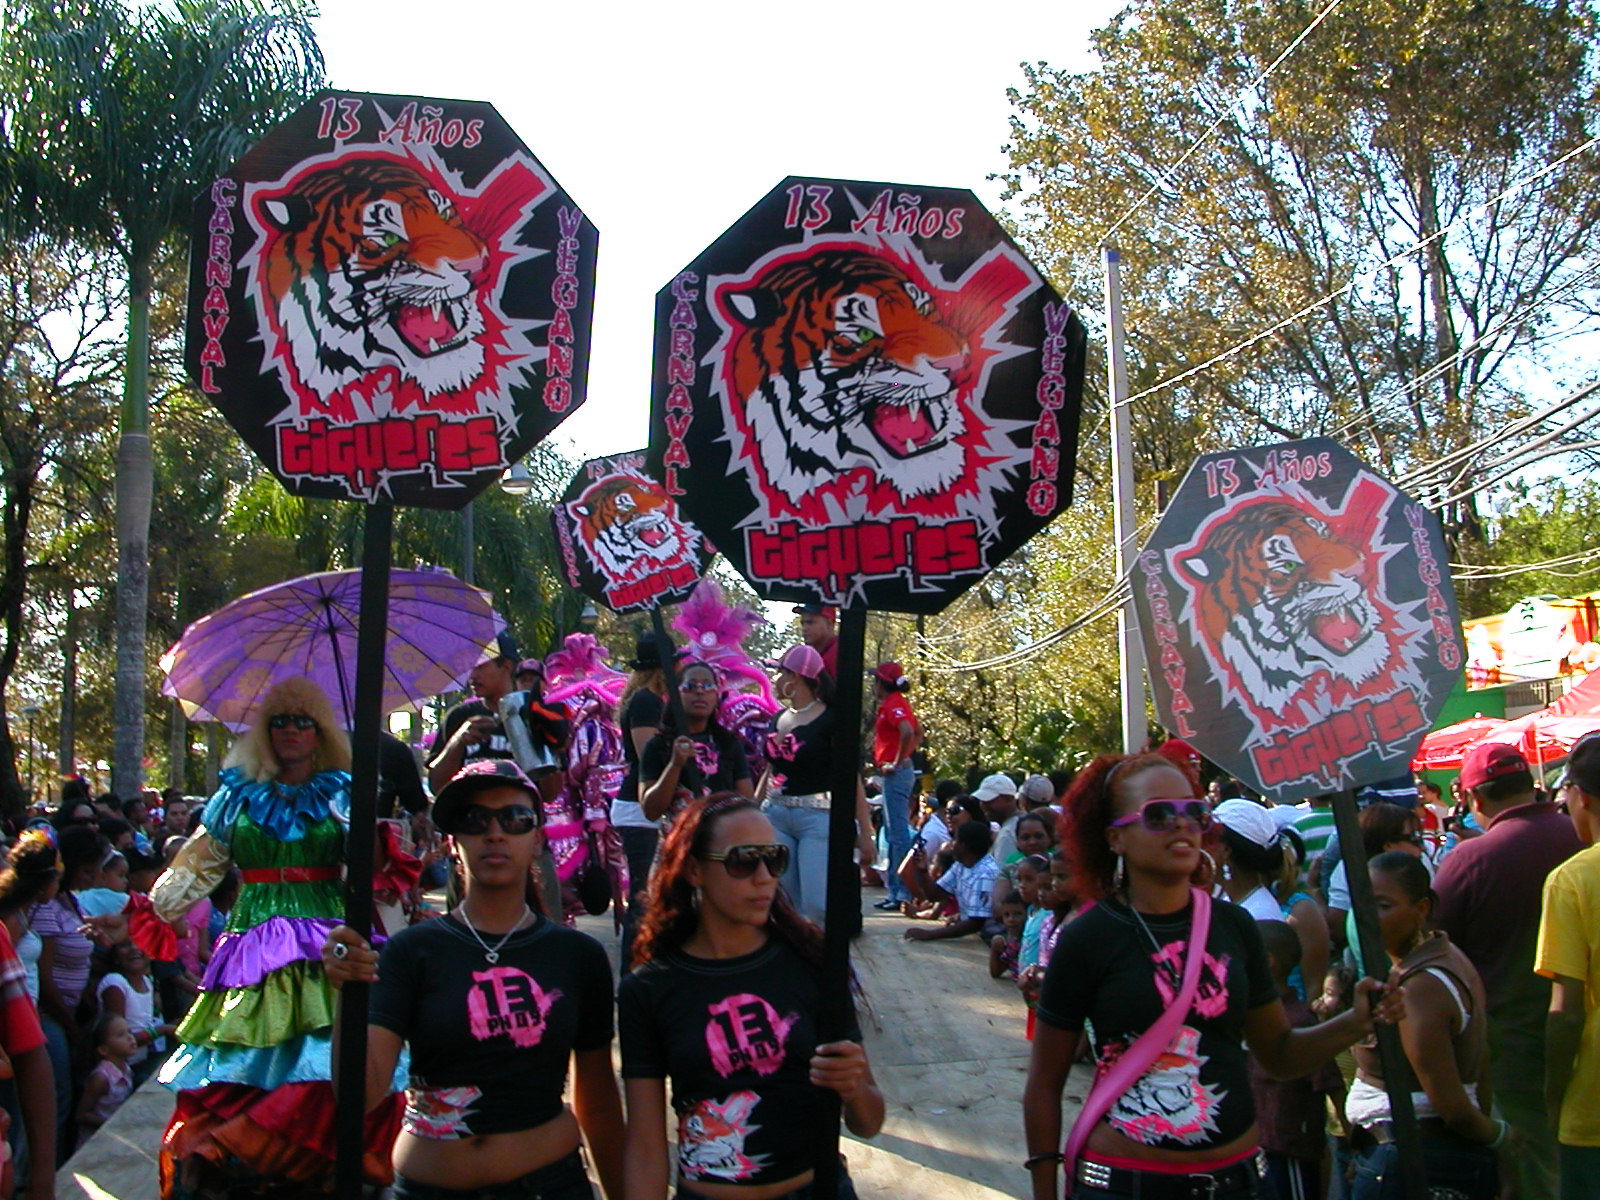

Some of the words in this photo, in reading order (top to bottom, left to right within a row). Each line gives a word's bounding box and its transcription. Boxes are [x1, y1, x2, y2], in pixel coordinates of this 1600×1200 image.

[317, 97, 363, 140] 13
[378, 101, 485, 148] Años
[200, 178, 237, 394] CARNAVAL
[784, 183, 834, 229] 13
[851, 188, 965, 239] Años
[542, 205, 583, 413] VEGANO
[664, 271, 699, 495] CARNAVAL
[1025, 301, 1071, 516] VEGANO
[1202, 457, 1241, 498] 13
[1254, 449, 1332, 489] Años
[1139, 549, 1198, 739] CARNAVAL
[1403, 503, 1462, 671] VEGANO
[477, 975, 540, 1016] 13
[714, 1001, 773, 1051] 13
